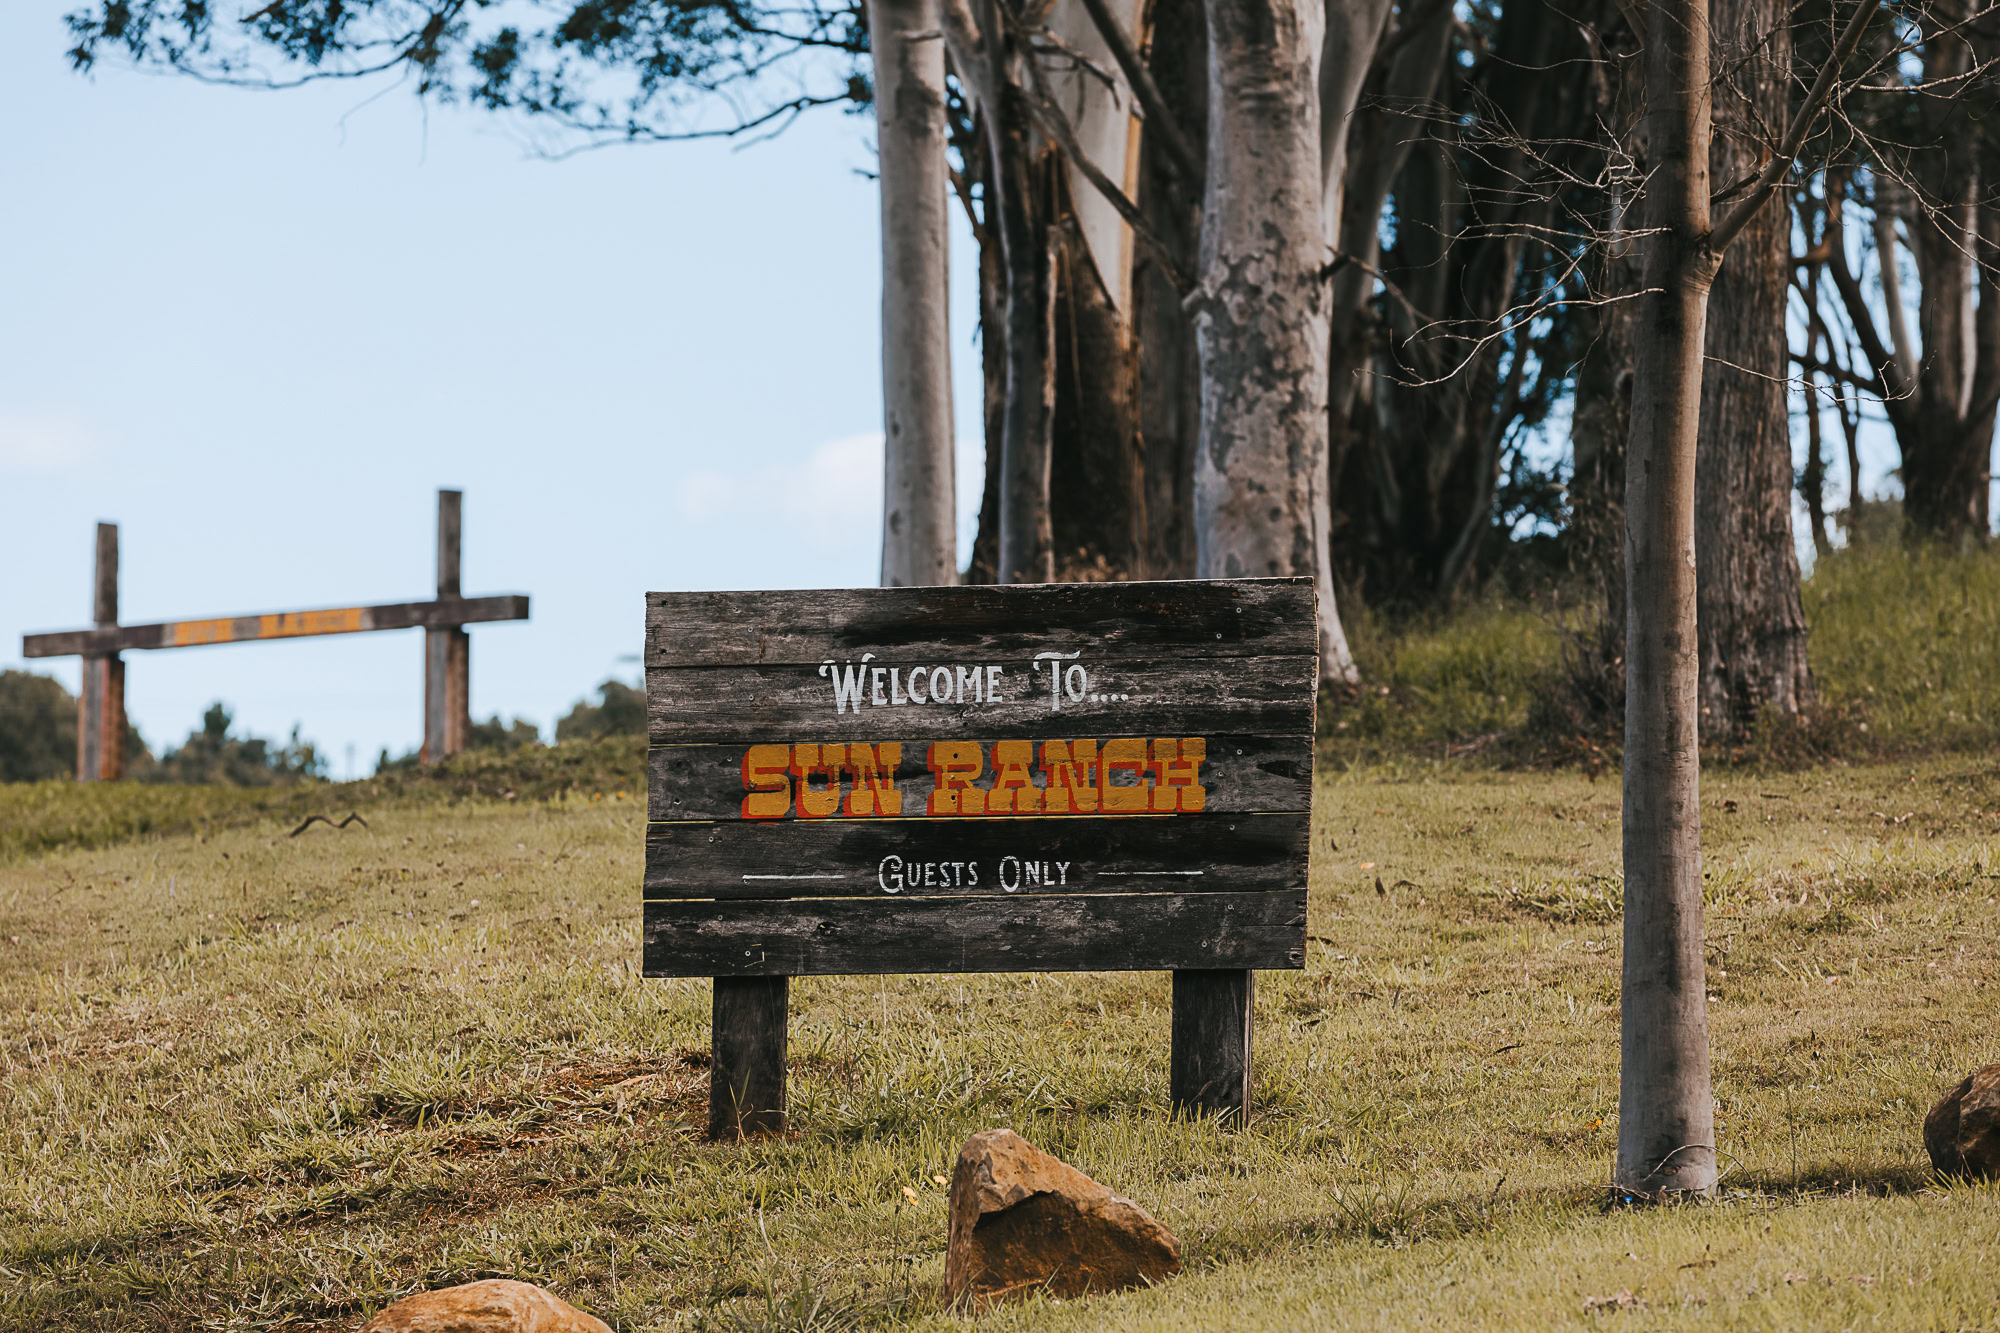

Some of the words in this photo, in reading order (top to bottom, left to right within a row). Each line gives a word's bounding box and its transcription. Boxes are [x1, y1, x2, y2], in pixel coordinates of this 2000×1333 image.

[818, 652, 1003, 715] WELCOME
[741, 742, 902, 819] SUN
[927, 737, 1207, 817] RANCH
[878, 855, 979, 893] GUESTS
[999, 855, 1071, 893] ONLY
